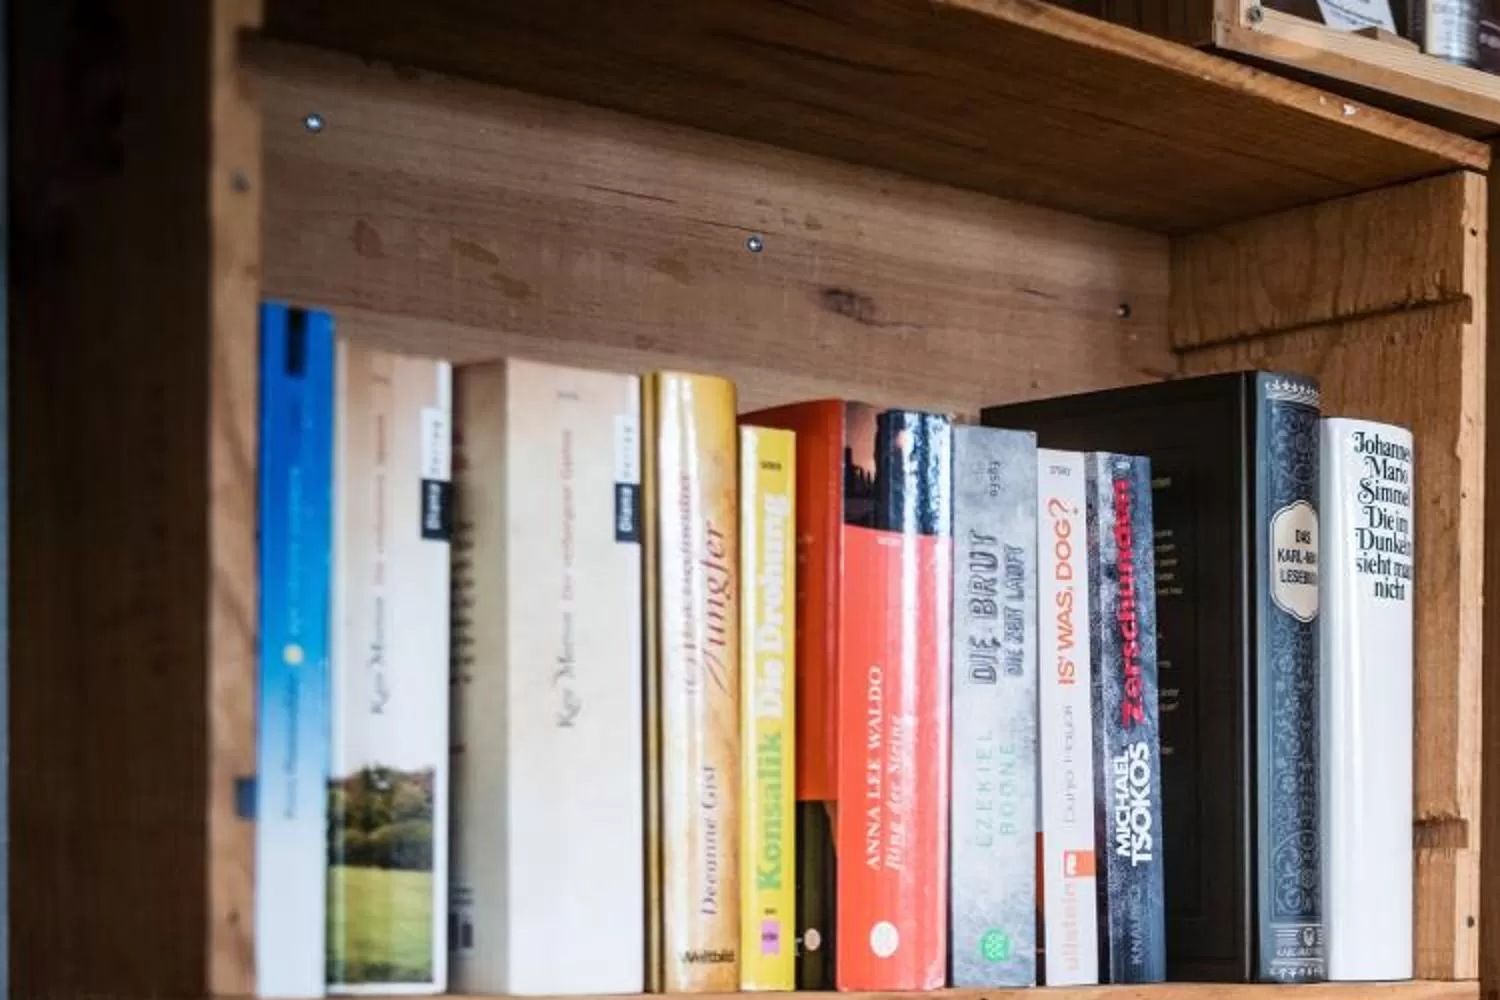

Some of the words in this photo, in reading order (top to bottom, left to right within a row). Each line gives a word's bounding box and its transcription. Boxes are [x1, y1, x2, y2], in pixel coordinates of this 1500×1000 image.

[1353, 431, 1410, 463] Johanne
[618, 486, 633, 532] Diana
[1363, 505, 1395, 531] Die
[1048, 498, 1079, 581] DOG?
[1356, 551, 1392, 577] sieht
[757, 492, 788, 654] Drohung
[968, 527, 999, 621] BRUT
[1374, 576, 1406, 601] nicht
[1004, 606, 1024, 645] ZEIT
[968, 634, 1001, 685] DIE
[1004, 650, 1024, 677] DIE
[755, 660, 784, 719] Die
[867, 667, 882, 749] WALDO
[866, 757, 881, 799] LEE
[886, 775, 902, 814] der
[976, 729, 993, 848] EZEKIEL
[999, 742, 1017, 837] BOONE
[1114, 752, 1132, 857] MICHAEL
[1128, 741, 1153, 867] TSOKOS
[757, 733, 783, 891] Konsalik
[865, 807, 881, 870] ANNA
[886, 819, 904, 870] Ring
